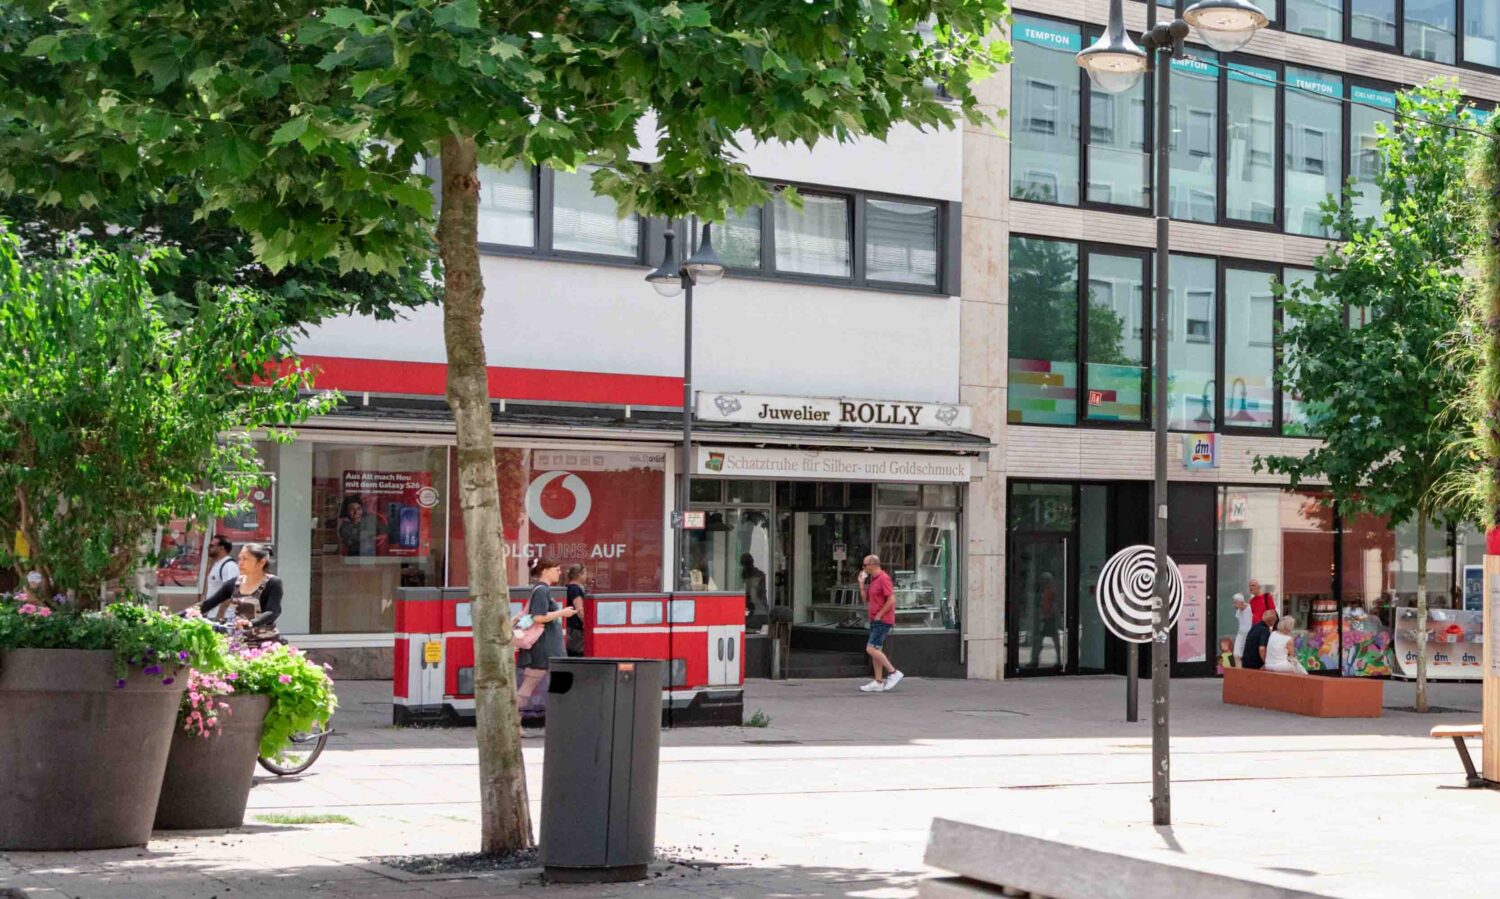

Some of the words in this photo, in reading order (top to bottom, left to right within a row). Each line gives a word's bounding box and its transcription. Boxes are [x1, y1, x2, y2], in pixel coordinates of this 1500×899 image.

[1024, 28, 1070, 46] TEMPTON
[1172, 57, 1208, 70] EMPTON
[1295, 79, 1333, 94] TEMPTON
[758, 403, 830, 421] Juwelier
[839, 402, 923, 425] ROLLY
[1194, 439, 1209, 454] dm
[727, 455, 798, 472] Schatztruhe
[803, 458, 821, 472] für
[823, 458, 862, 474] Silber-
[865, 460, 886, 474] und
[889, 460, 965, 476] Goldschmuck
[345, 472, 360, 480] Aus
[360, 481, 378, 489] dem
[378, 481, 405, 490] Galaxy
[502, 543, 546, 558] OLGT
[550, 543, 588, 559] UNS
[591, 543, 627, 559] AUF
[1434, 651, 1448, 662] dm
[1462, 652, 1476, 662] dm
